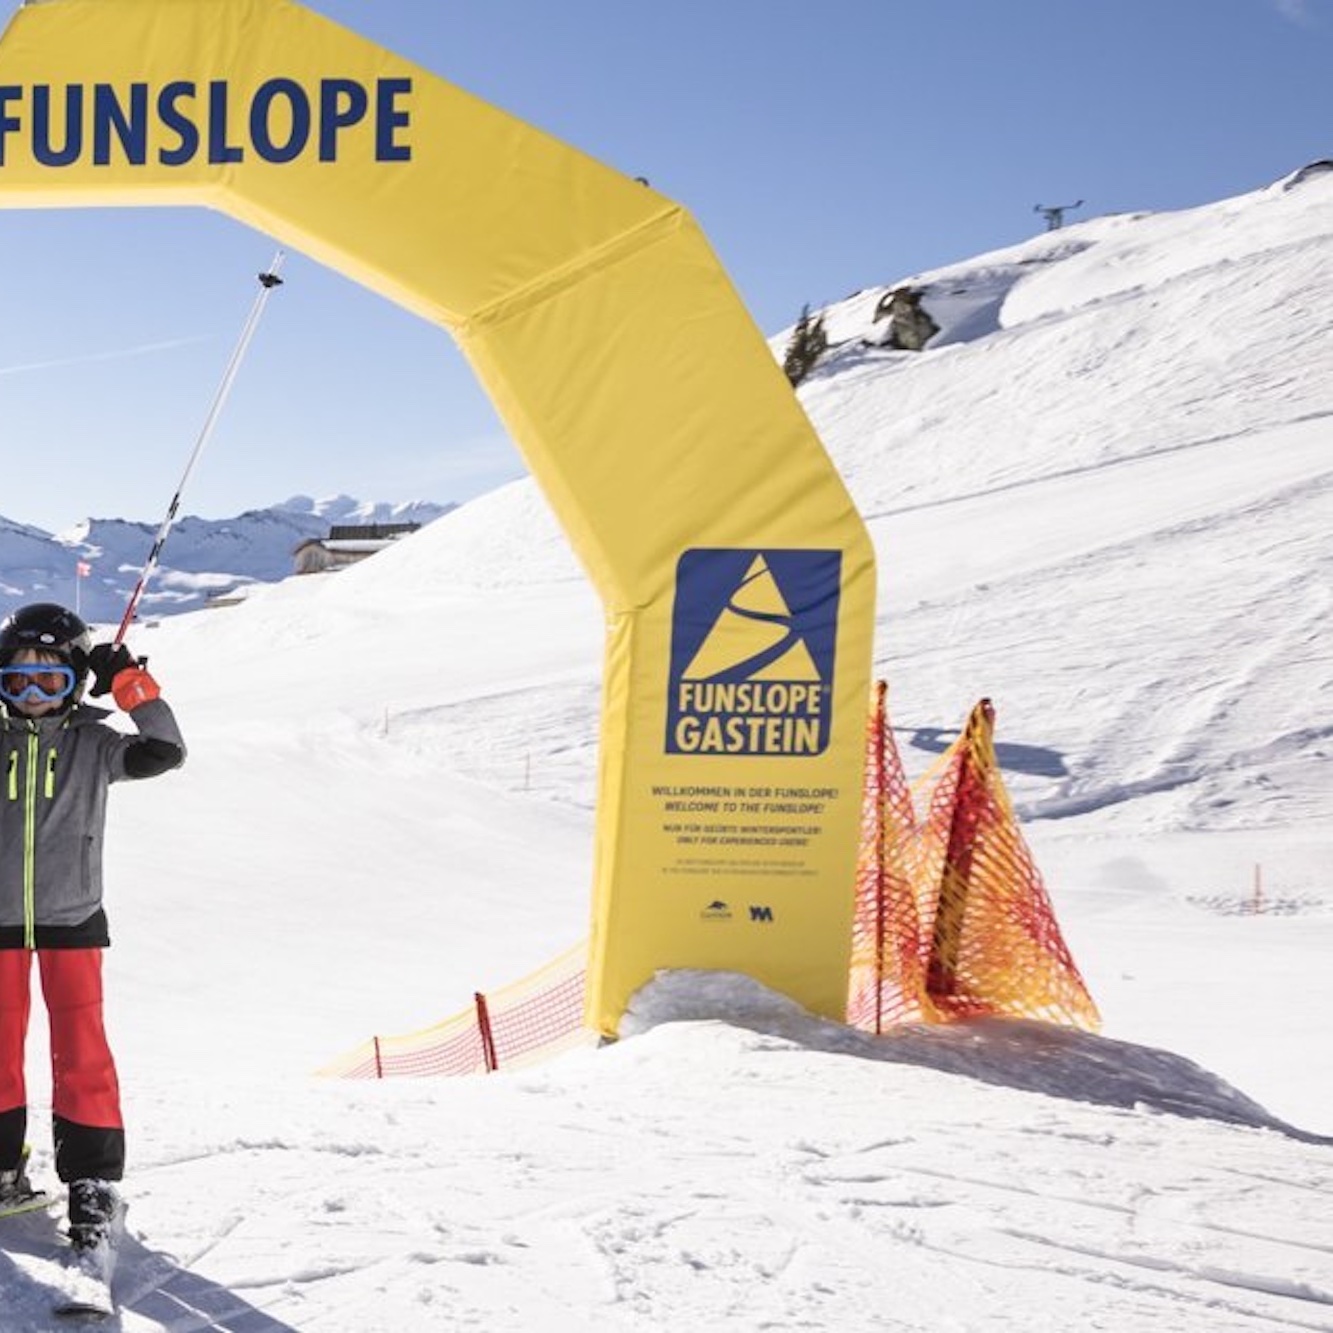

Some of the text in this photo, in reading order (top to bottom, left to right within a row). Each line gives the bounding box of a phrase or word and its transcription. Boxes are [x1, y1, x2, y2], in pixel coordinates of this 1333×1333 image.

[679, 683, 821, 714] FUNSLOPE
[675, 716, 821, 753] GASTEIN
[652, 786, 839, 799] WILLKOMMEN IN DER FUNSLOPE!
[665, 801, 825, 814] WELCOME TO THE FUNSLOPE!
